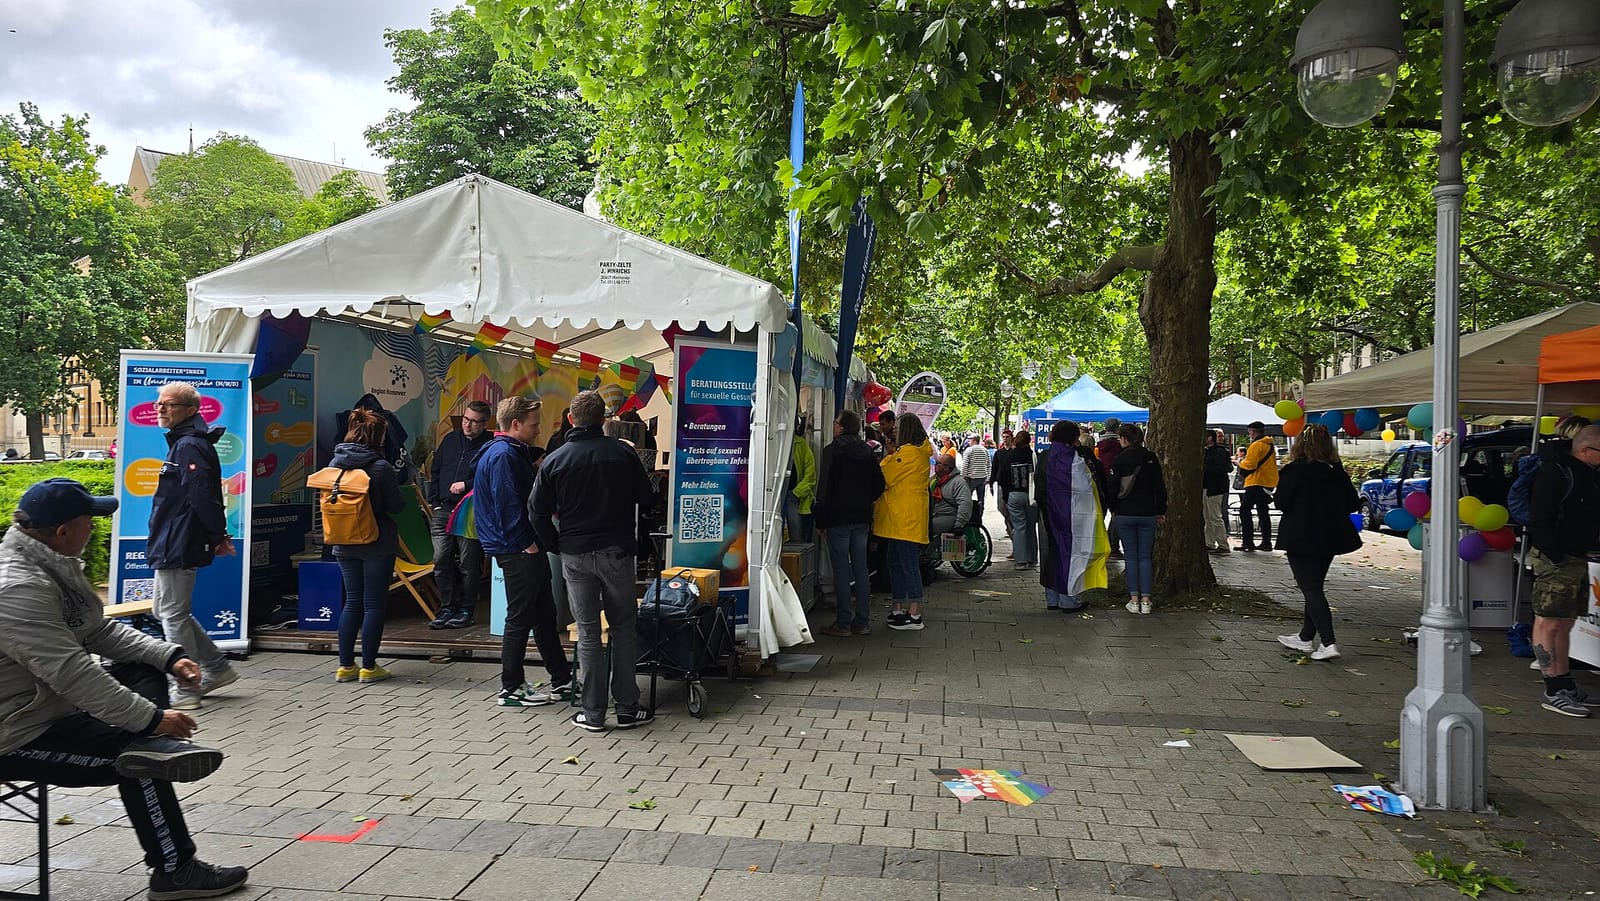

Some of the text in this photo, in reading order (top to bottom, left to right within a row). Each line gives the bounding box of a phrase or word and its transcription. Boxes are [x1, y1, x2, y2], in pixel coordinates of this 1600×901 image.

[691, 390, 752, 401] für sexuelle Gesun
[689, 422, 726, 431] Beratungen
[688, 446, 742, 455] Tests auf sexuell
[686, 456, 749, 466] übertragbare Infek
[681, 480, 719, 489] Mehr Infos:
